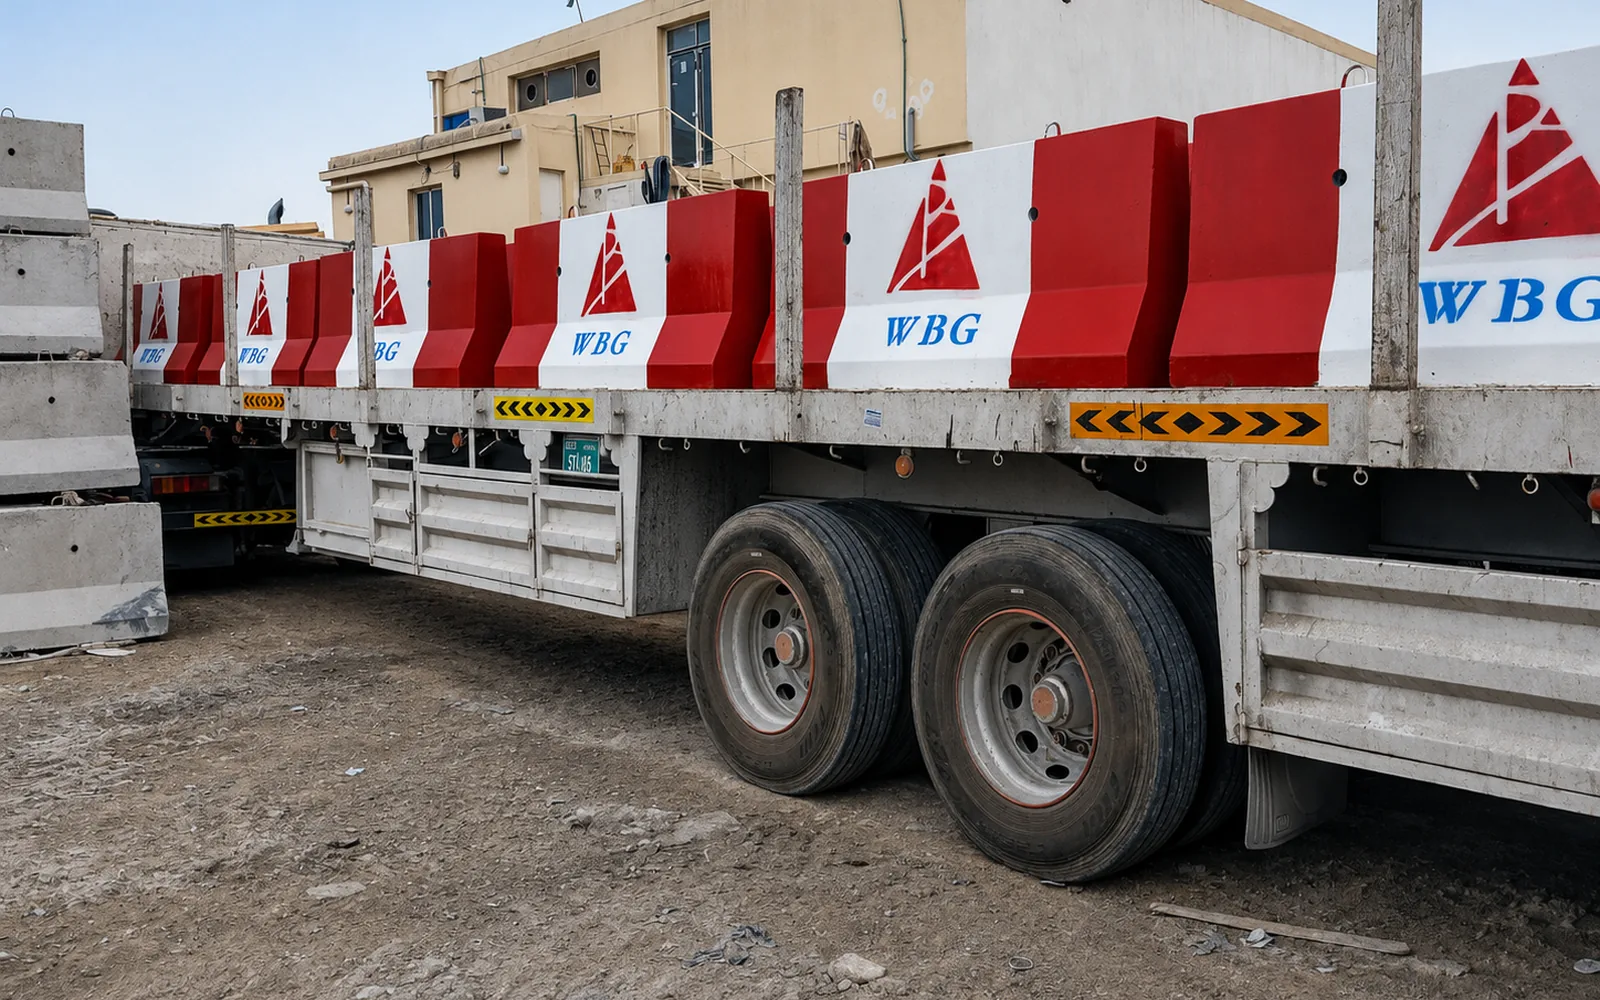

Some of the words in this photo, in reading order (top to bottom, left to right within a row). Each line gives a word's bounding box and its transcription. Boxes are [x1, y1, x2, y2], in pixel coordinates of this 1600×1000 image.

[1418, 275, 1600, 325] WBG
[886, 313, 982, 347] WBG
[374, 341, 401, 361] BG
[572, 330, 633, 356] WBG
[140, 347, 165, 363] WBG
[238, 347, 269, 364] WBG
